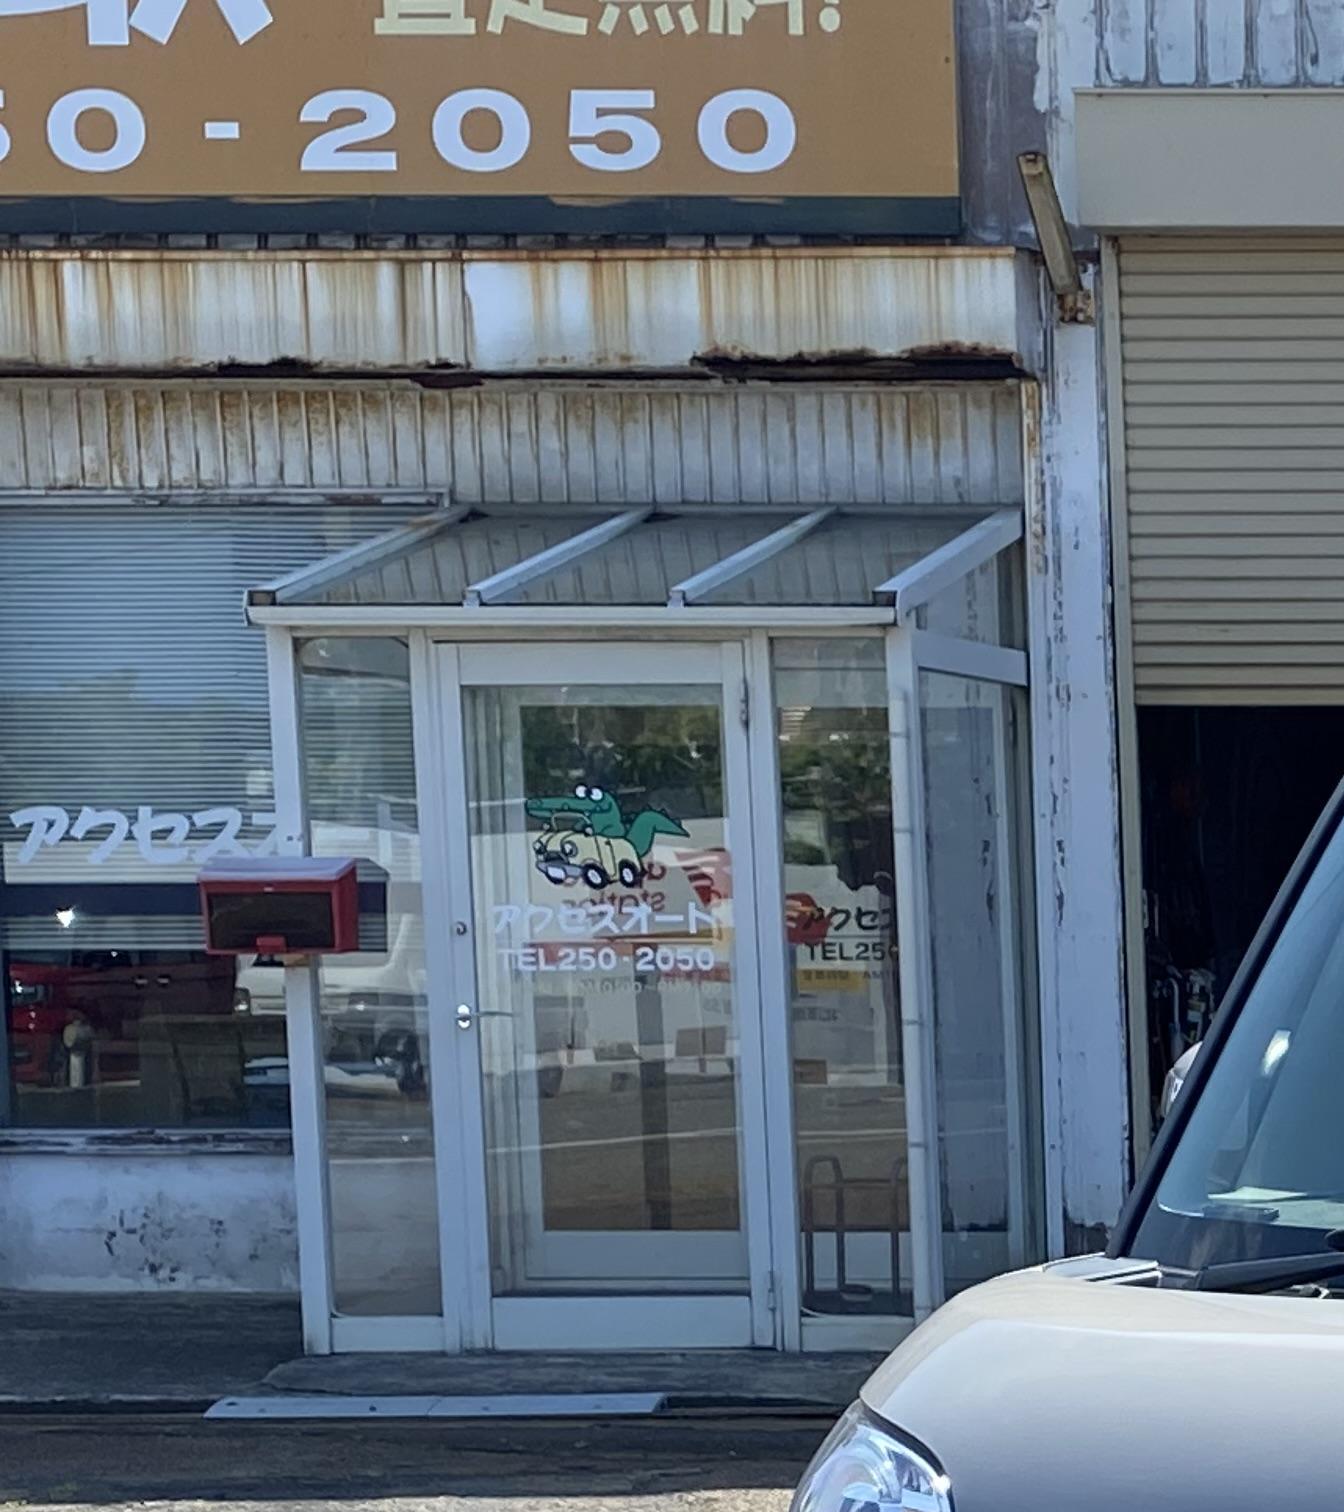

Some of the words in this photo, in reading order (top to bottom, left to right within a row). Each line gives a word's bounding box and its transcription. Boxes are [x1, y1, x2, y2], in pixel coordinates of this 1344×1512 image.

[490, 901, 716, 935] アクセスオート
